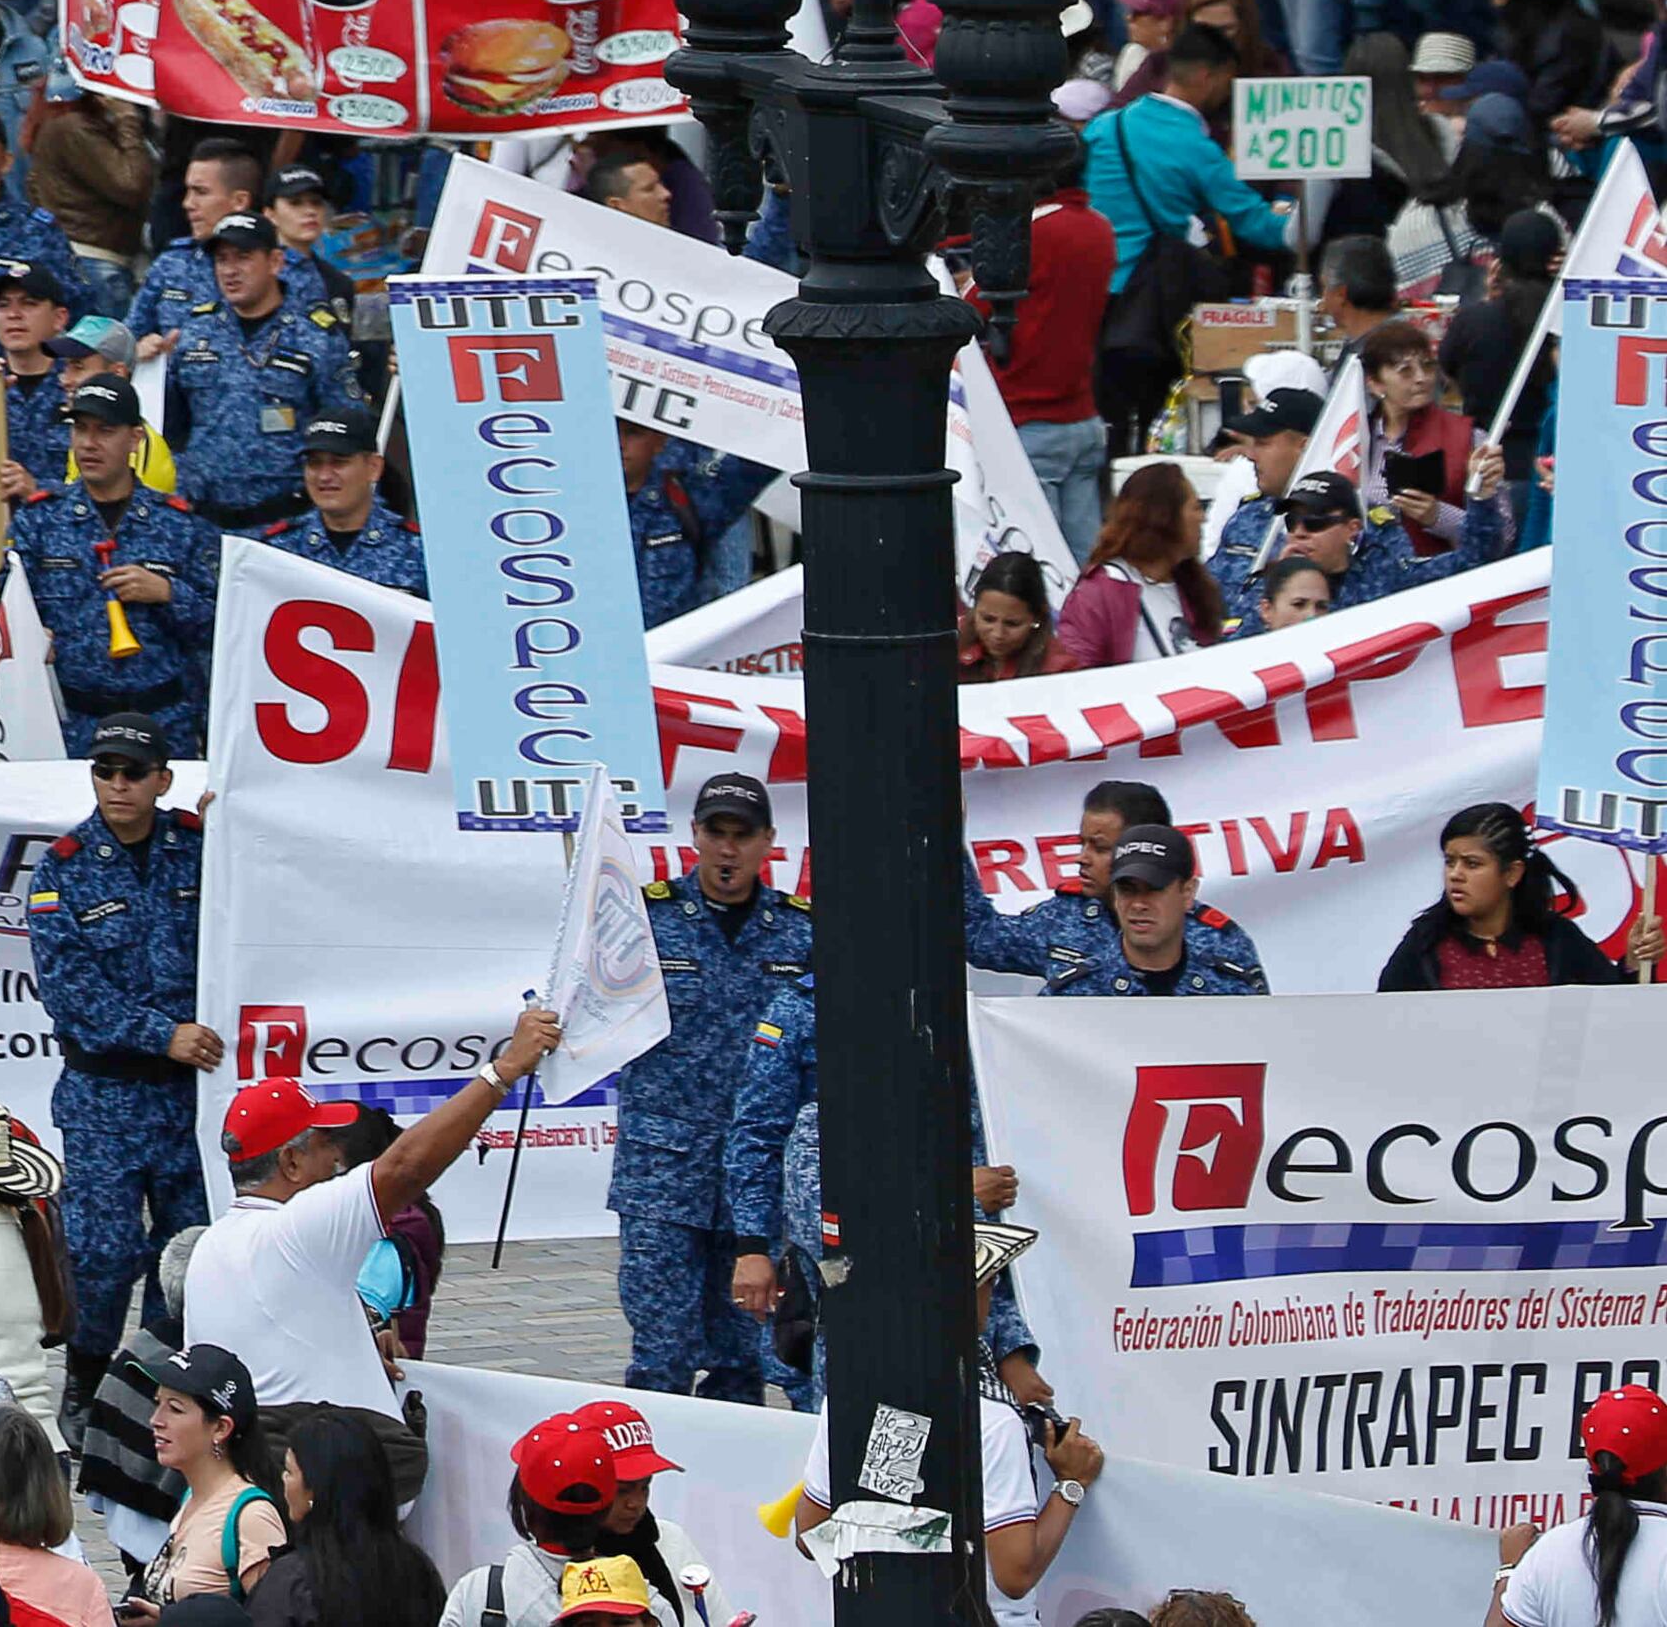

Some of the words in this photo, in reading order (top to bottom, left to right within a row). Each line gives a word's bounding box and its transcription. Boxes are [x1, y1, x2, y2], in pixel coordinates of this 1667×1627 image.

[1244, 81, 1366, 127] MINUTOS
[1248, 134, 1263, 160] A
[1267, 126, 1348, 170] 200
[416, 293, 581, 331] UTC
[1113, 1303, 1223, 1356] Federación
[1229, 1303, 1337, 1350] Colombiana
[1342, 1292, 1366, 1338] de
[1372, 1287, 1511, 1339] Trabajadores
[1516, 1285, 1553, 1331] del
[1558, 1284, 1645, 1330] Sistema
[1207, 1363, 1549, 1477] SINTRAPEC
